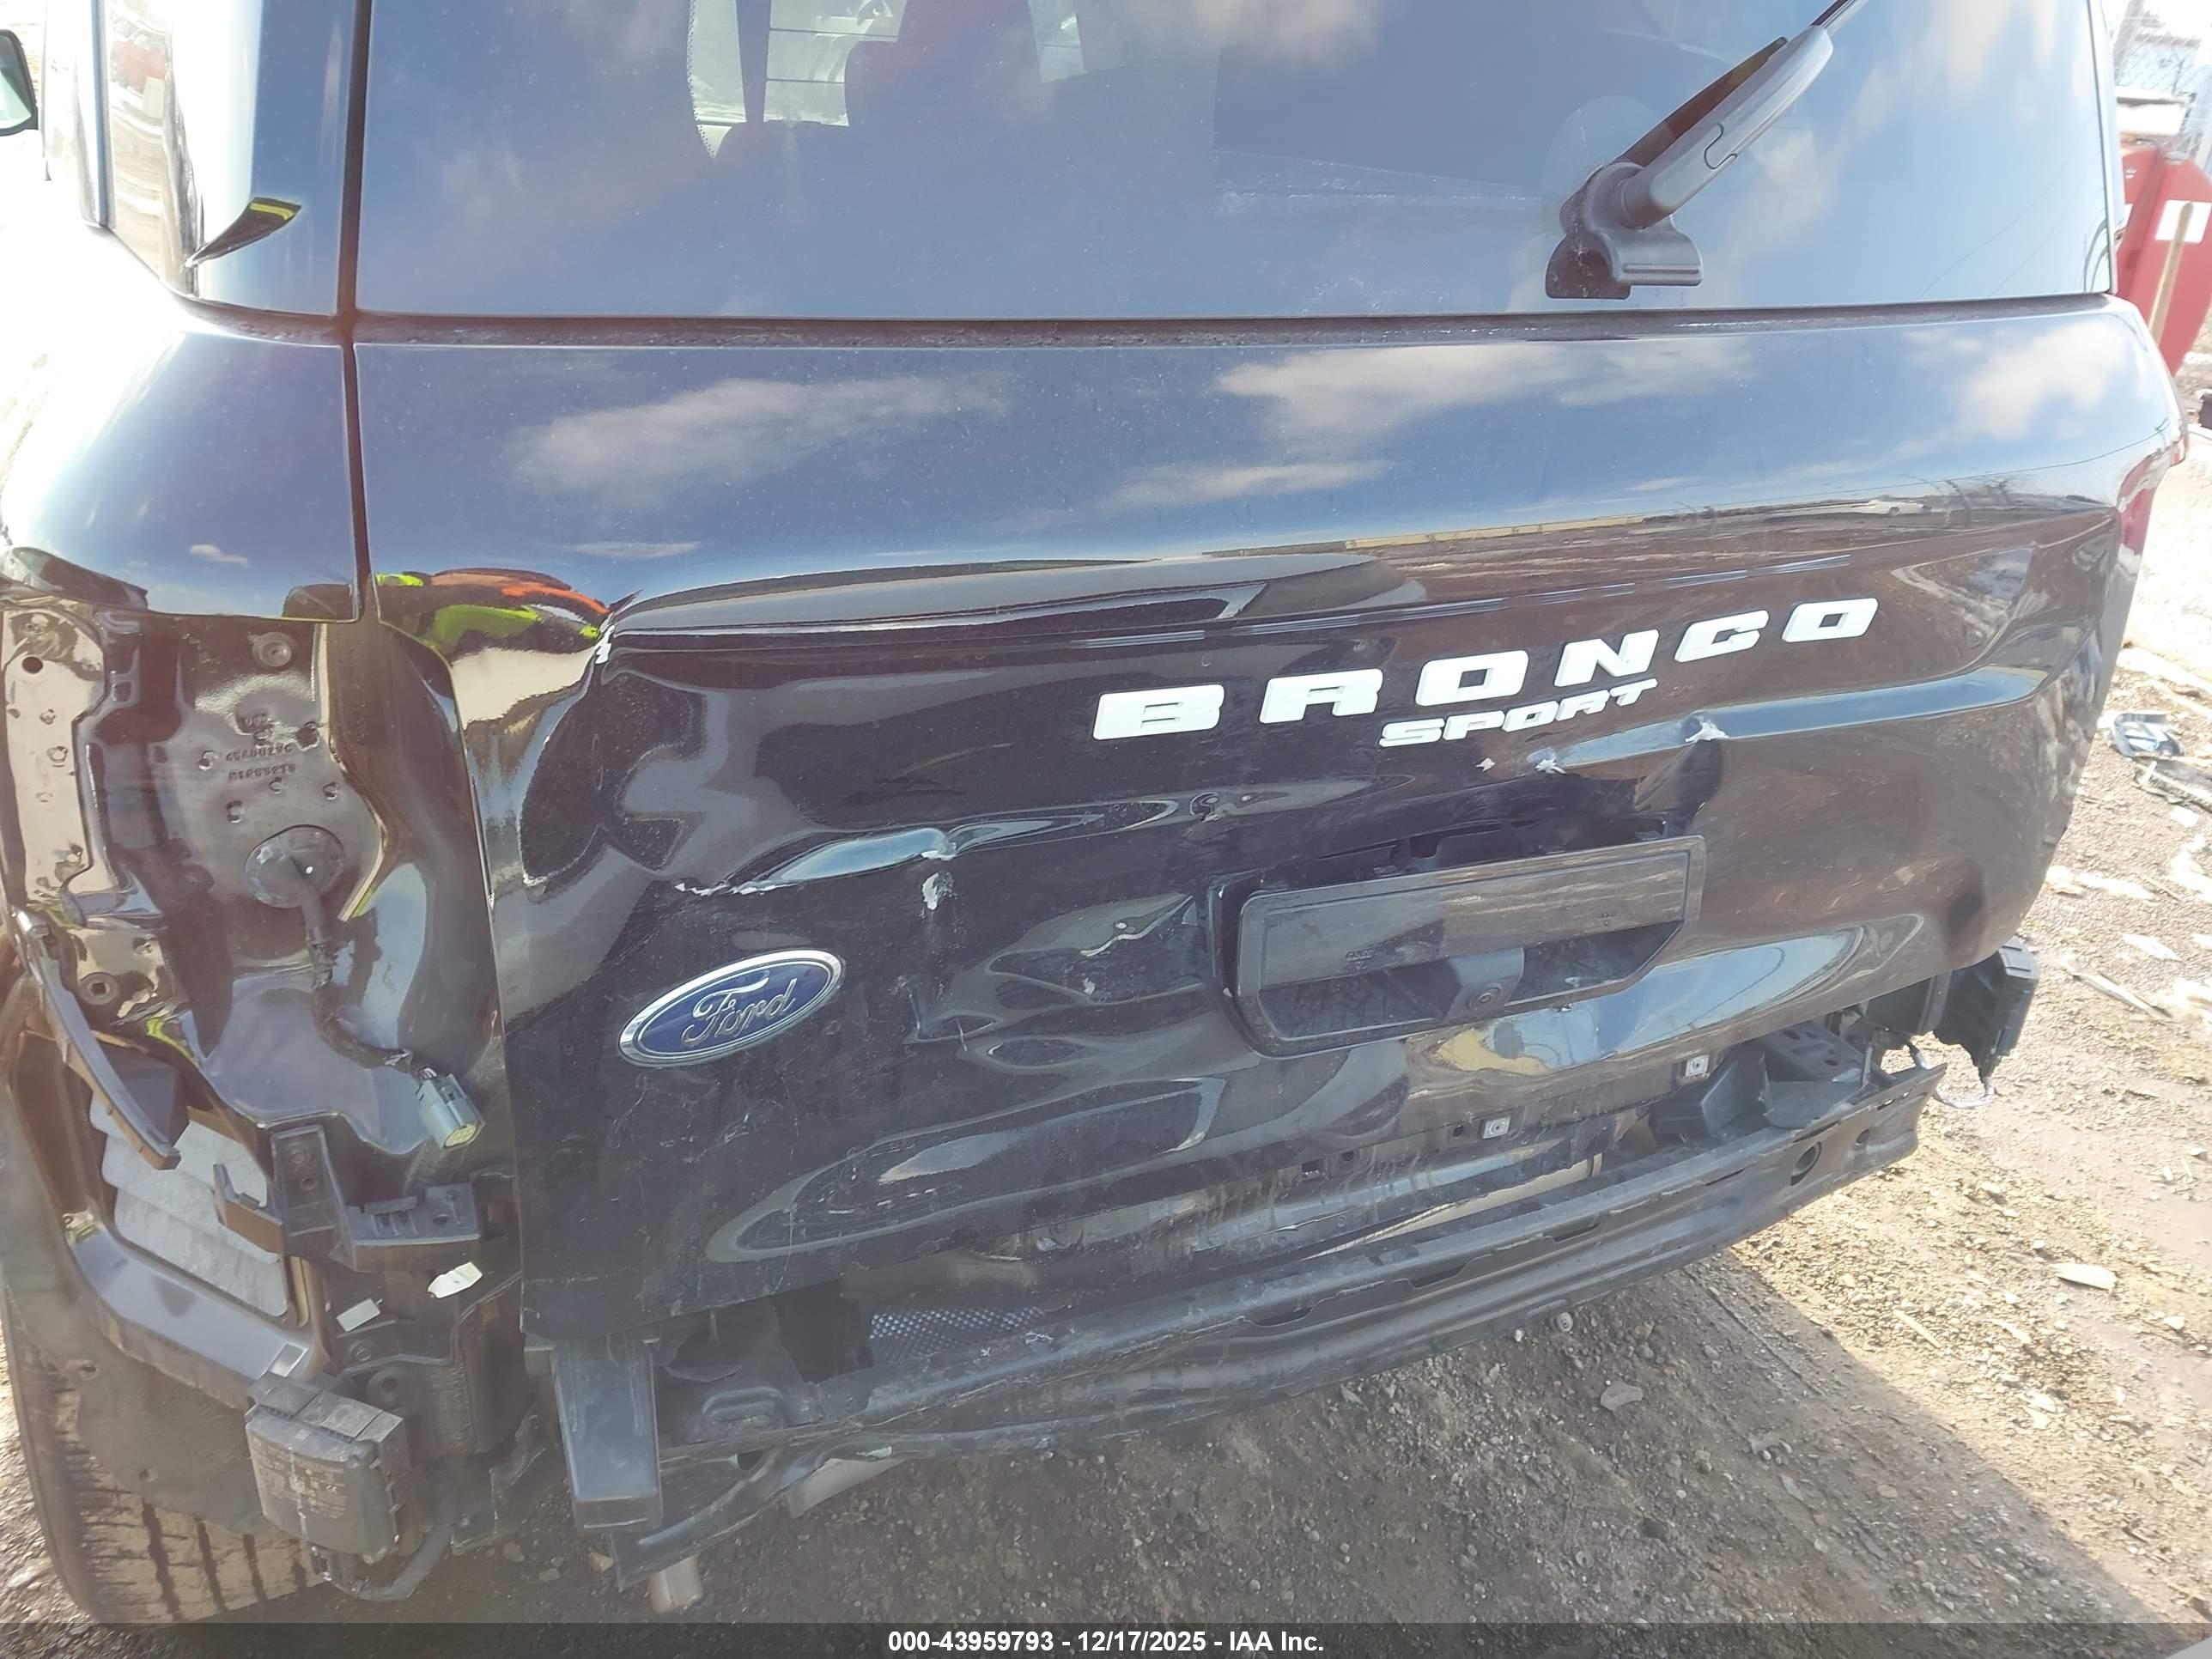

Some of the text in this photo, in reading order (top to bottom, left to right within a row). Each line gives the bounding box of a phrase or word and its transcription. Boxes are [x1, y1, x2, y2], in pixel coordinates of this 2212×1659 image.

[1092, 597, 1879, 741] BRONCO
[1378, 678, 1658, 749] SPORT
[681, 969, 798, 1048] Ford
